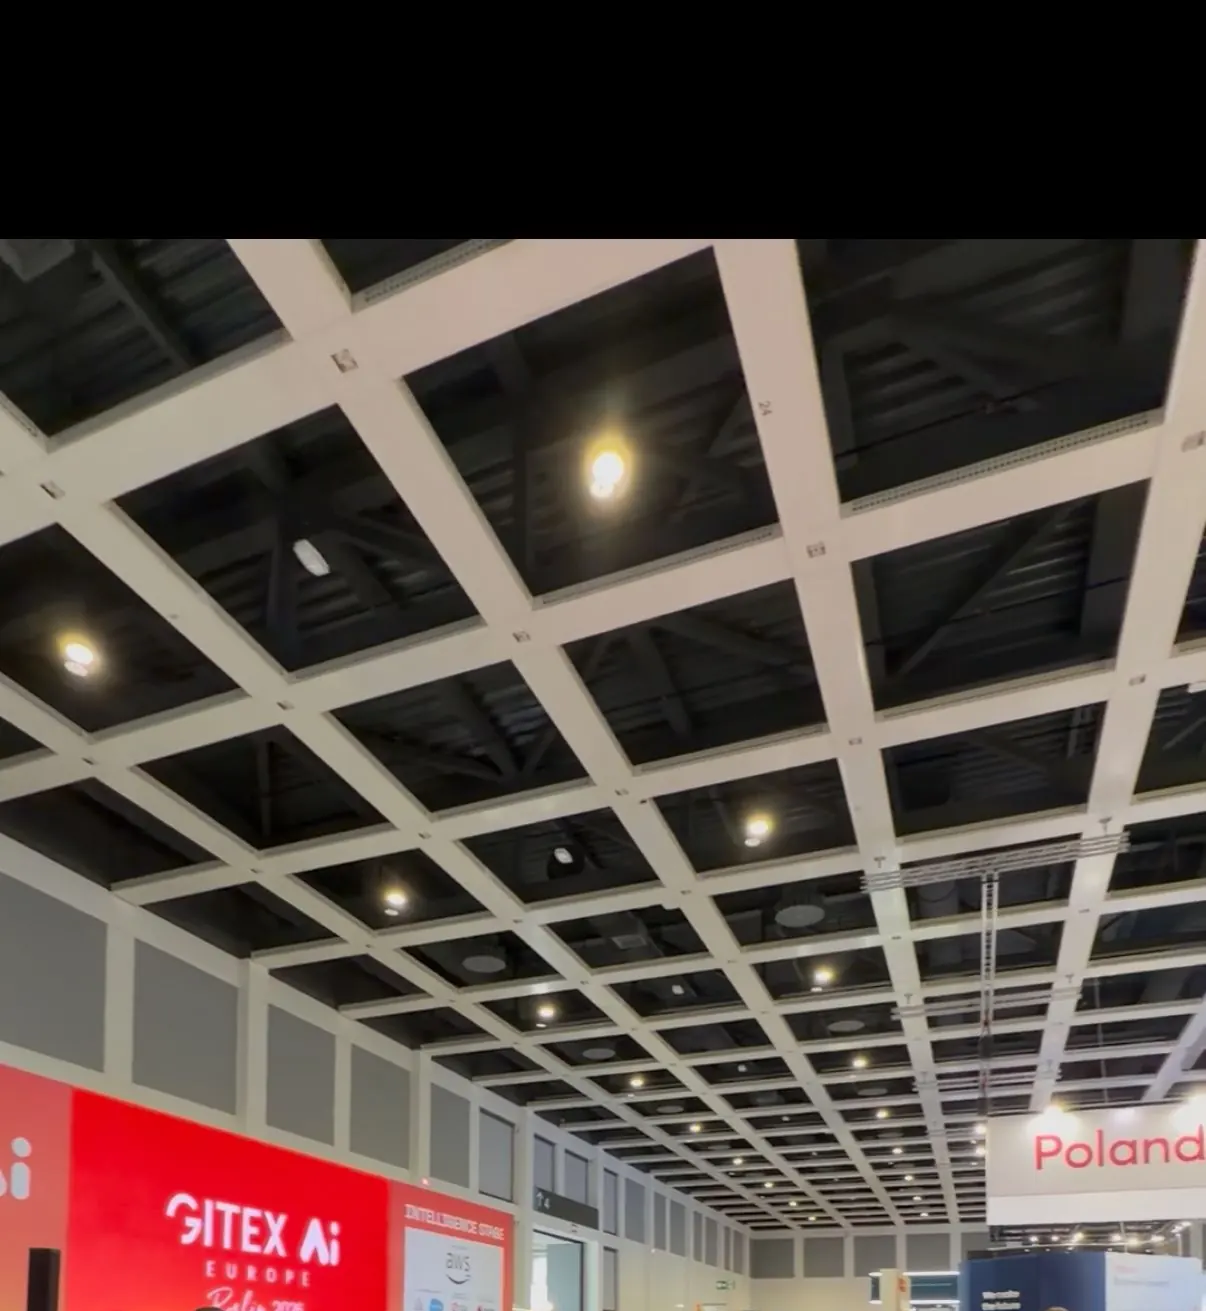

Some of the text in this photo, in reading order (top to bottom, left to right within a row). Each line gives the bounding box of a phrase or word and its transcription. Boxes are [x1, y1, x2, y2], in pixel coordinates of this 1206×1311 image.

[0, 1136, 32, 1200] i
[1034, 1124, 1206, 1170] Poland
[165, 1192, 341, 1267] GITEX Ai
[205, 1260, 310, 1288] EUROPE
[446, 1252, 471, 1272] aws
